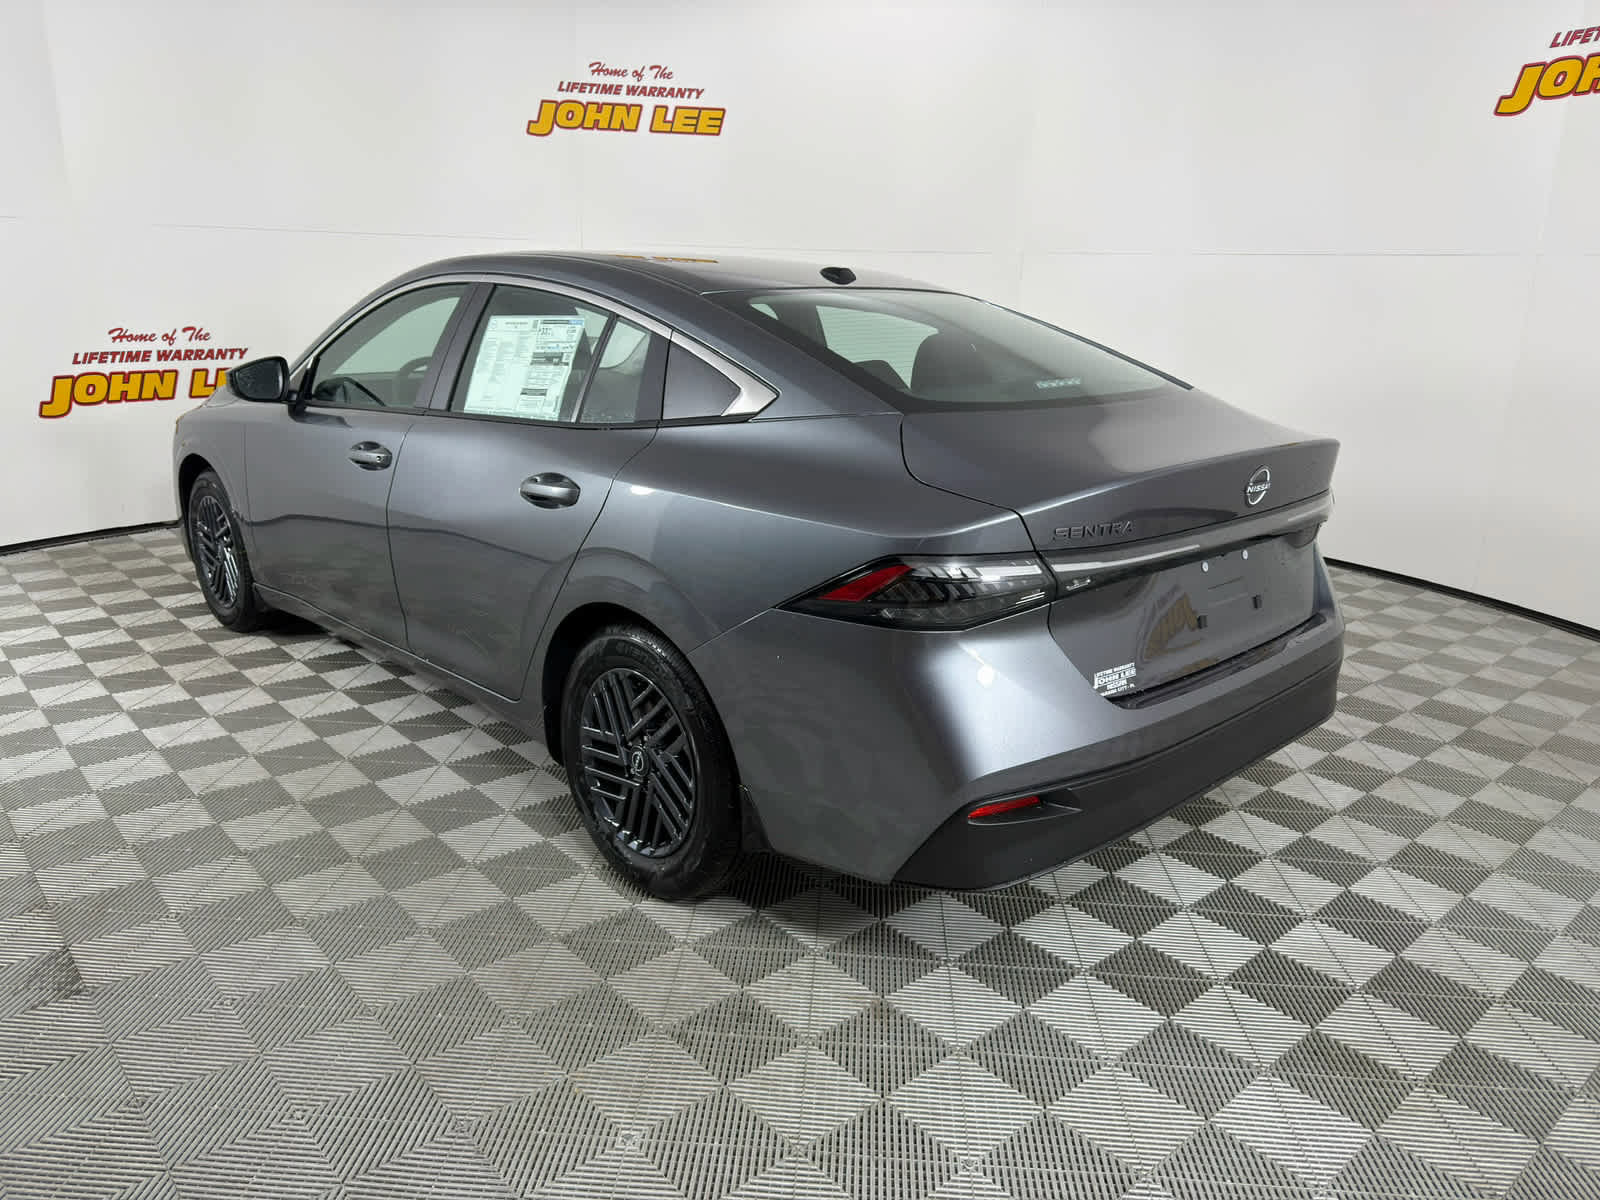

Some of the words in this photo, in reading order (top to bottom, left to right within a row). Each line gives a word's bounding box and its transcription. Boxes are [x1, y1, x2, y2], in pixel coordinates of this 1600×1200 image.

[1549, 26, 1600, 48] LIFE
[589, 62, 628, 77] Home
[631, 66, 645, 81] of
[649, 65, 673, 79] The
[557, 81, 623, 96] LIFETIME
[625, 84, 705, 99] WARRANTY
[1493, 52, 1600, 117] JOH
[527, 99, 643, 137] JOHN
[649, 105, 726, 136] LEE
[108, 327, 158, 343] Home
[161, 328, 177, 346] of
[182, 326, 211, 341] The
[72, 350, 151, 365] LIFETIME
[156, 347, 248, 362] WARRANTY
[39, 369, 178, 419] JOHN
[1053, 520, 1135, 540] SENTRA
